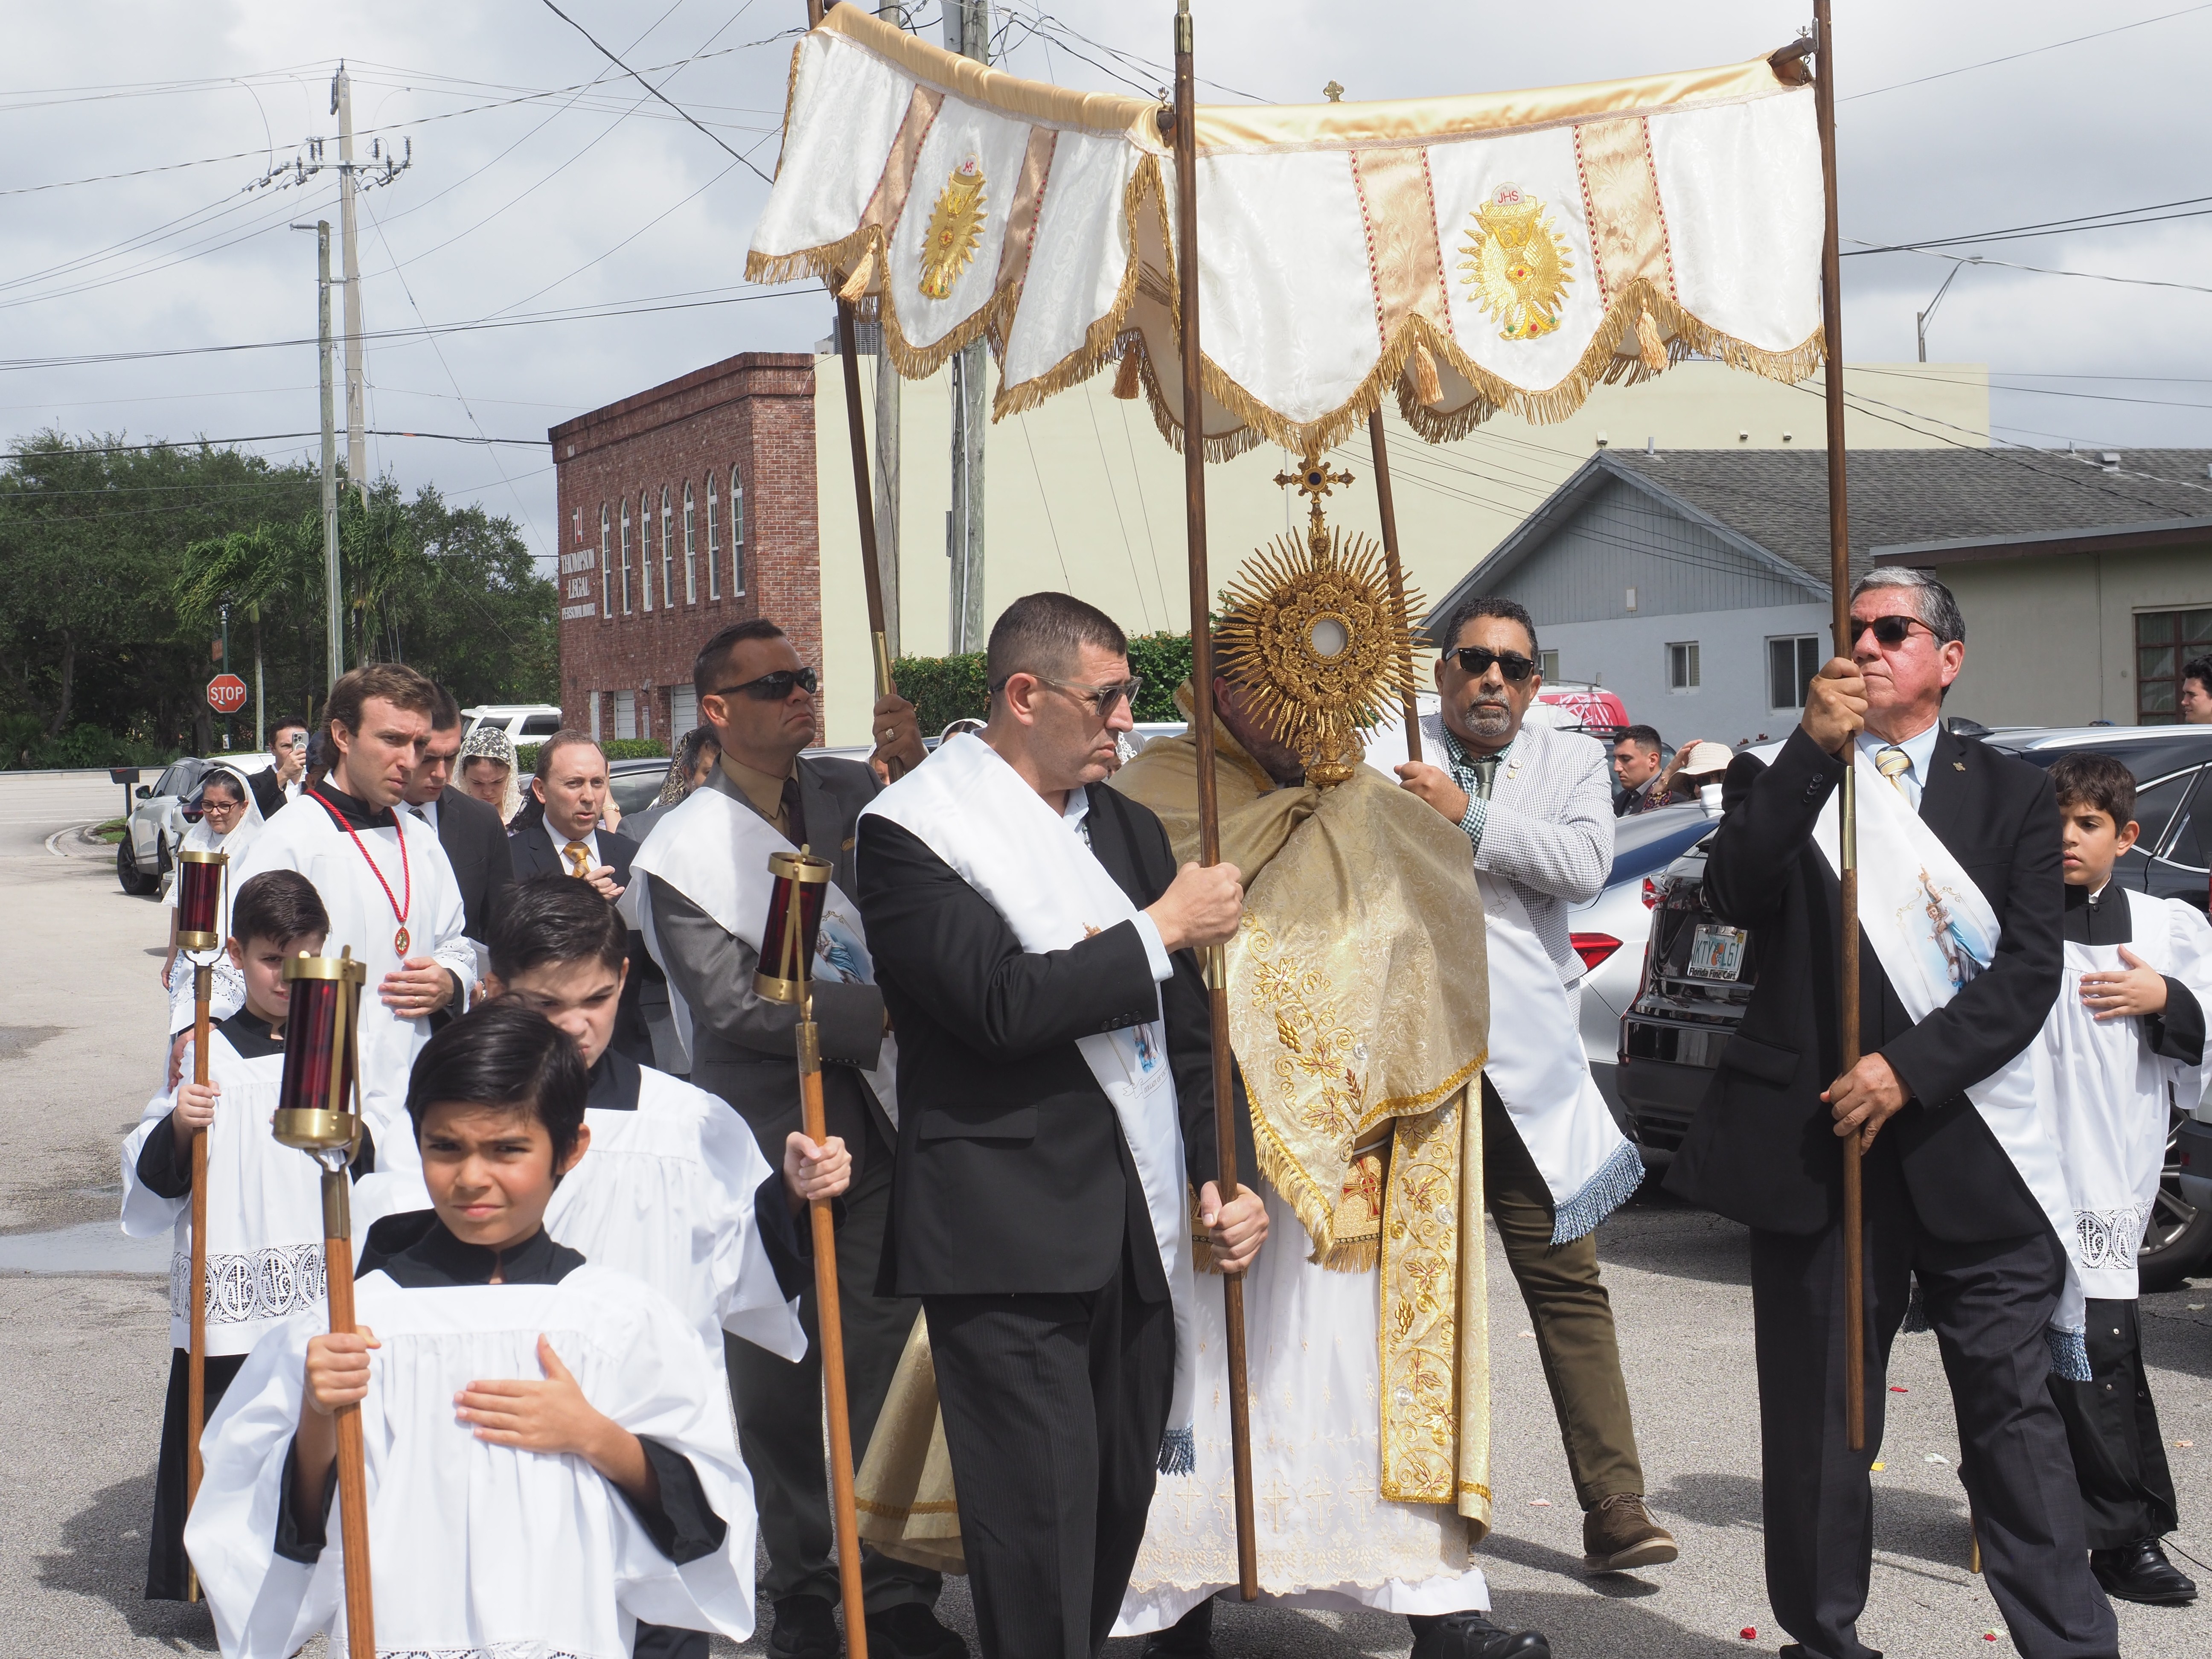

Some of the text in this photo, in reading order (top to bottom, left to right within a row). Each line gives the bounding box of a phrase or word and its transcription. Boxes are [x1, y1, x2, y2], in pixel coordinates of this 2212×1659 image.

[1498, 190, 1519, 204] JHS
[560, 548, 595, 574] THOMPSON
[568, 576, 590, 599] LEGAL
[210, 686, 243, 701] STOP
[1694, 940, 1740, 967] KTY L61
[1689, 967, 1736, 980] Florida Fine Cars
